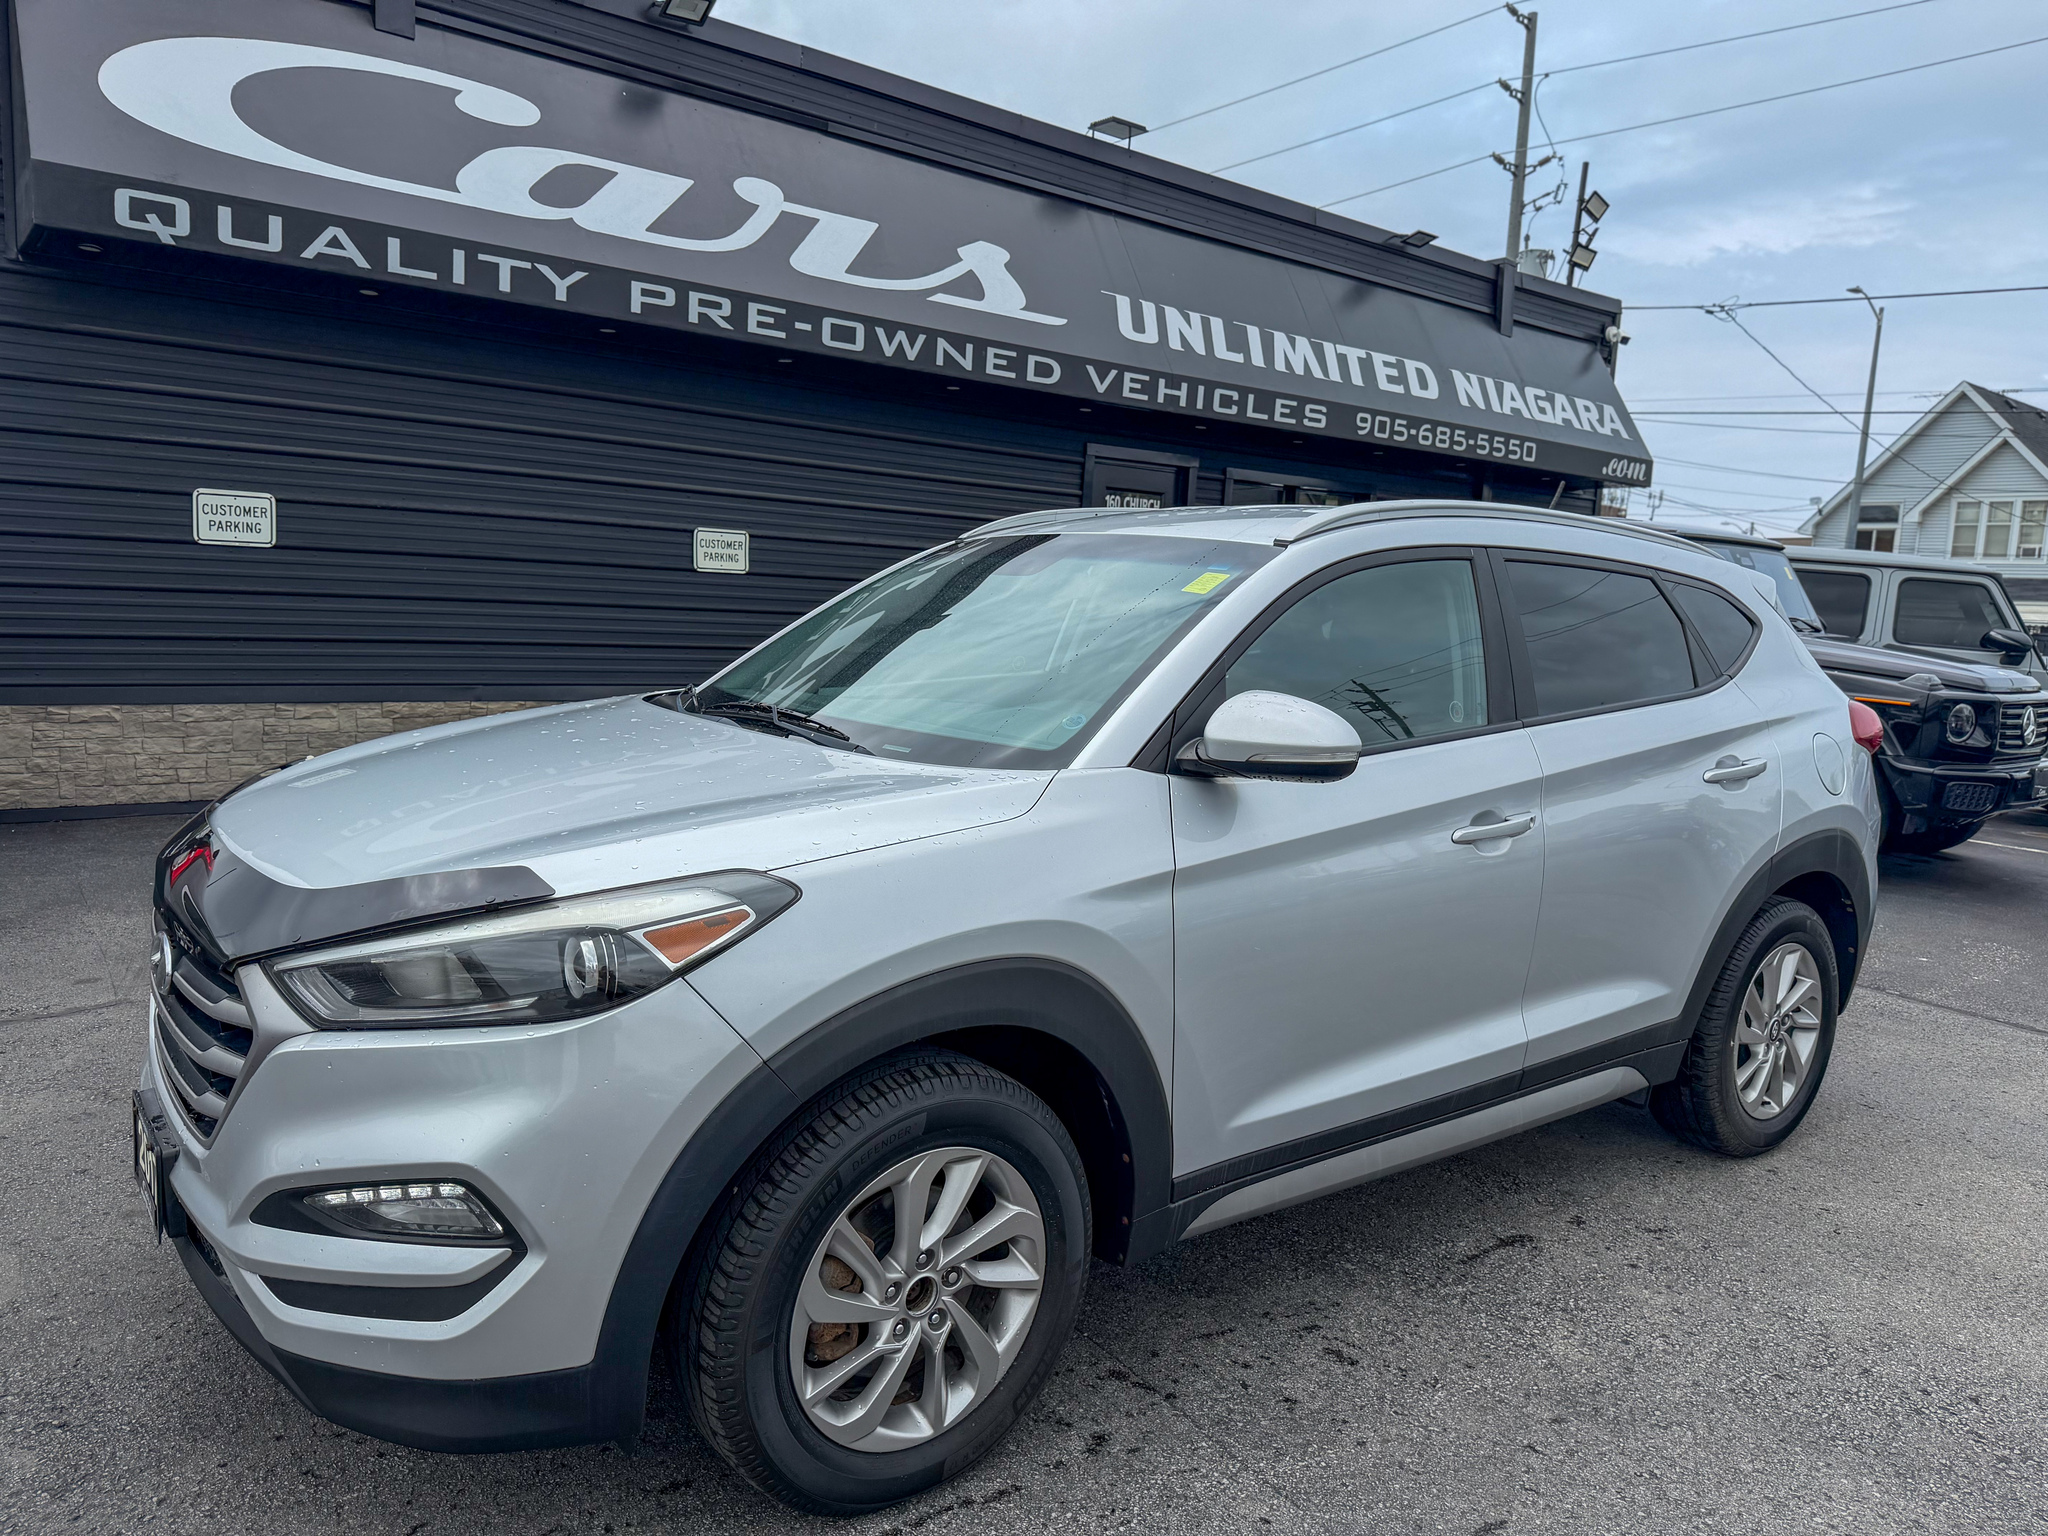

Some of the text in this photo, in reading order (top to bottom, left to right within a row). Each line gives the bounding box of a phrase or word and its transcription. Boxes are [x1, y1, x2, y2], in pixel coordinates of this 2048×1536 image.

[98, 37, 1631, 440] Cars UNLIMITED NIAGARA
[115, 188, 1537, 463] QUALITY PRE-OWNED VEHICLES 905-685-5550
[1602, 458, 1647, 481] .com
[202, 503, 268, 519] CUSTOMER
[1105, 494, 1161, 510] 160 CHURCH
[208, 519, 262, 534] PARKING
[699, 538, 744, 551] CUSTOMER
[703, 551, 740, 563] PARKING
[388, 899, 472, 922] TUON
[851, 1125, 913, 1173] DEFENDER
